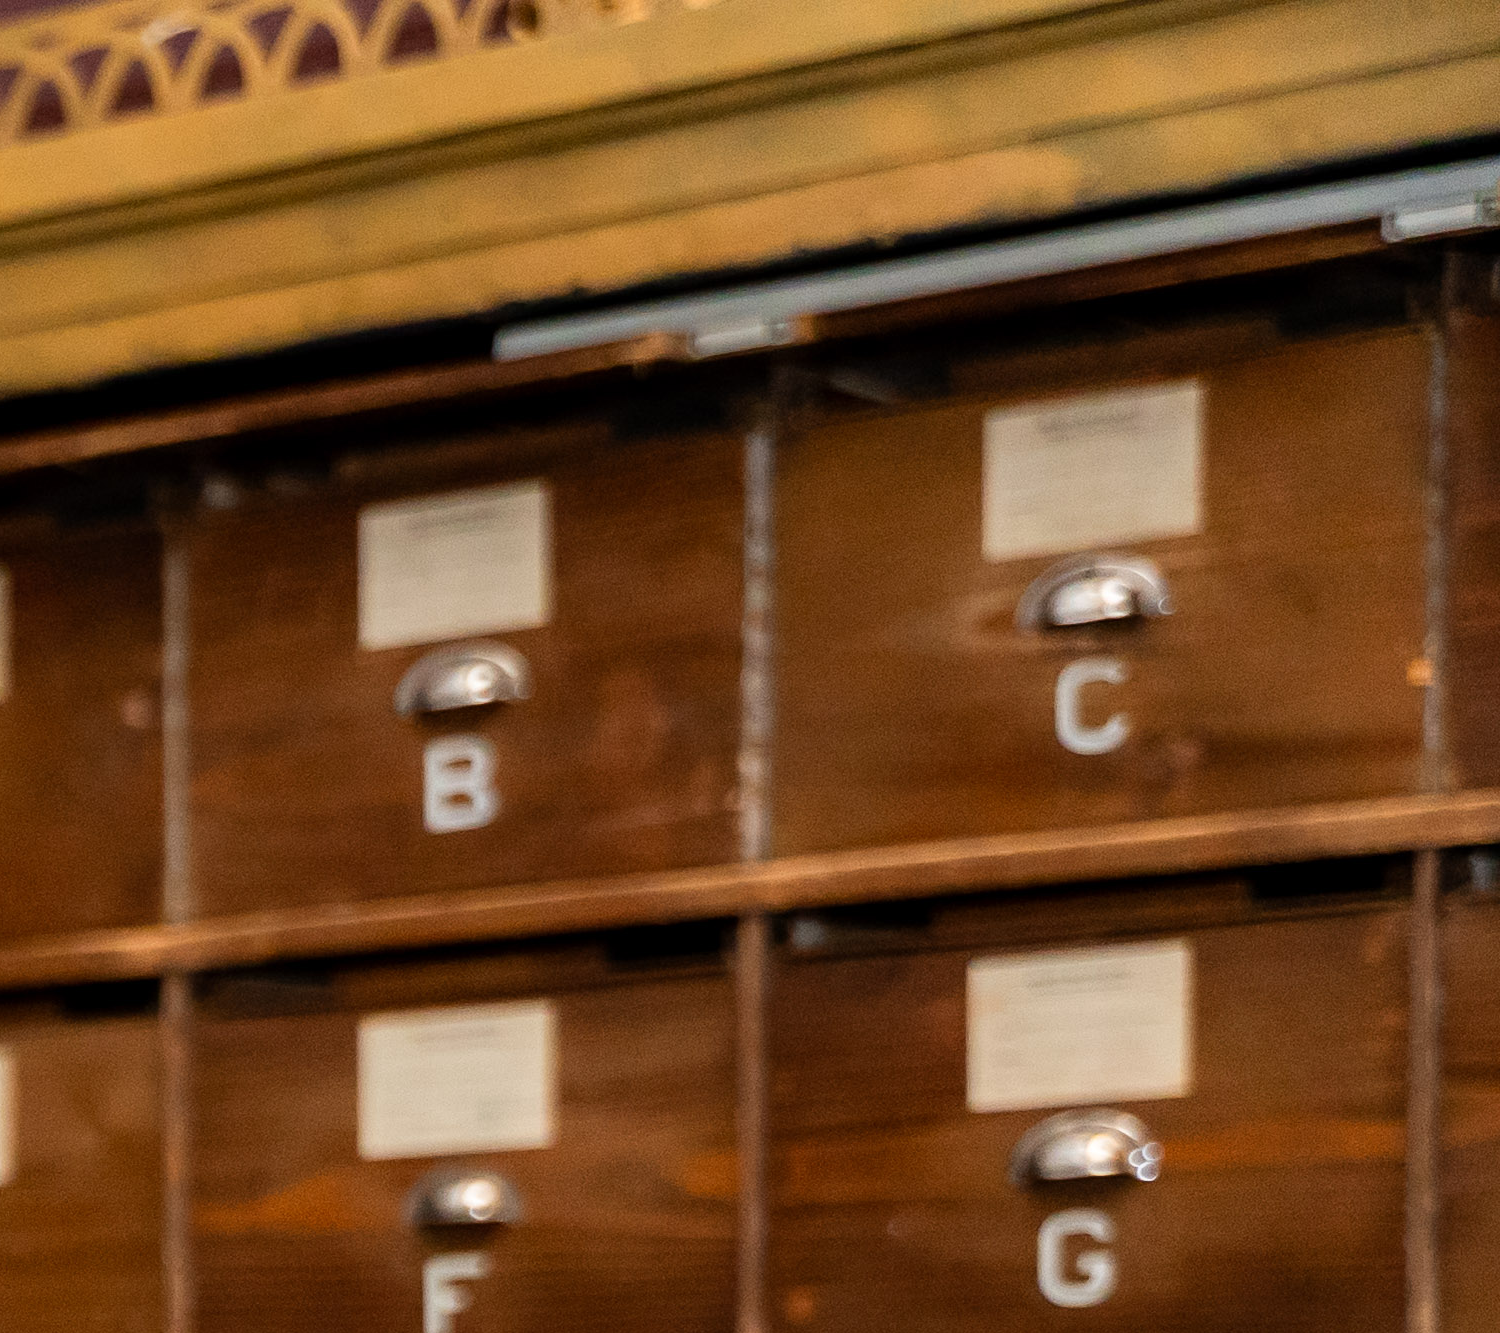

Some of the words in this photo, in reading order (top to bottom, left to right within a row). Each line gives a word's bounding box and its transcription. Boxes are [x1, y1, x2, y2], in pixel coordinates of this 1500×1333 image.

[1055, 659, 1129, 754] C
[424, 737, 498, 832] B
[1038, 1211, 1116, 1306] G
